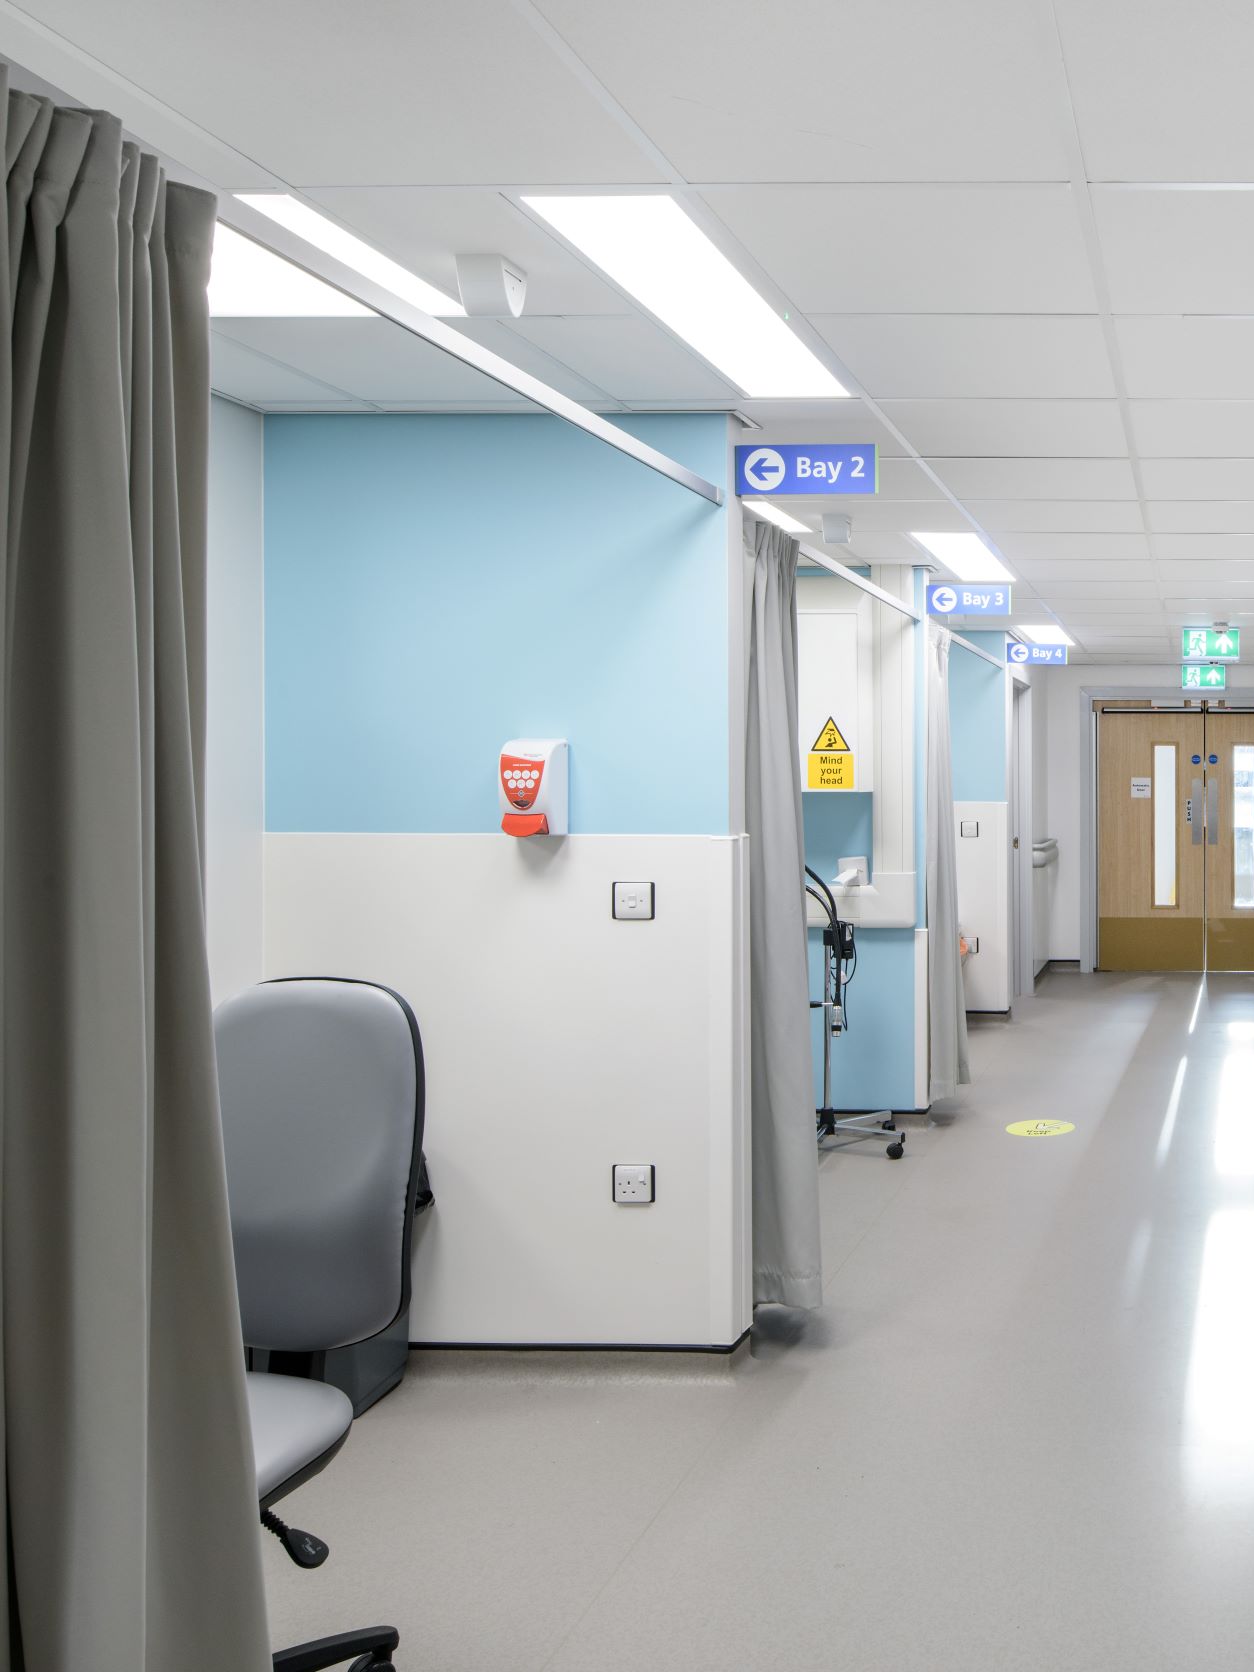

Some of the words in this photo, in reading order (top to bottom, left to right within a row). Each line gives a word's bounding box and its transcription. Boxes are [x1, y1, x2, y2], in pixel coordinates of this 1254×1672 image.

[796, 456, 843, 484] Bay
[850, 456, 865, 478] 2
[962, 592, 991, 609] Bay
[994, 592, 1004, 606] 3
[1032, 648, 1053, 660] Bay
[1055, 648, 1063, 658] 4
[820, 756, 843, 765] Mind
[820, 768, 842, 776] your
[820, 776, 843, 785] head
